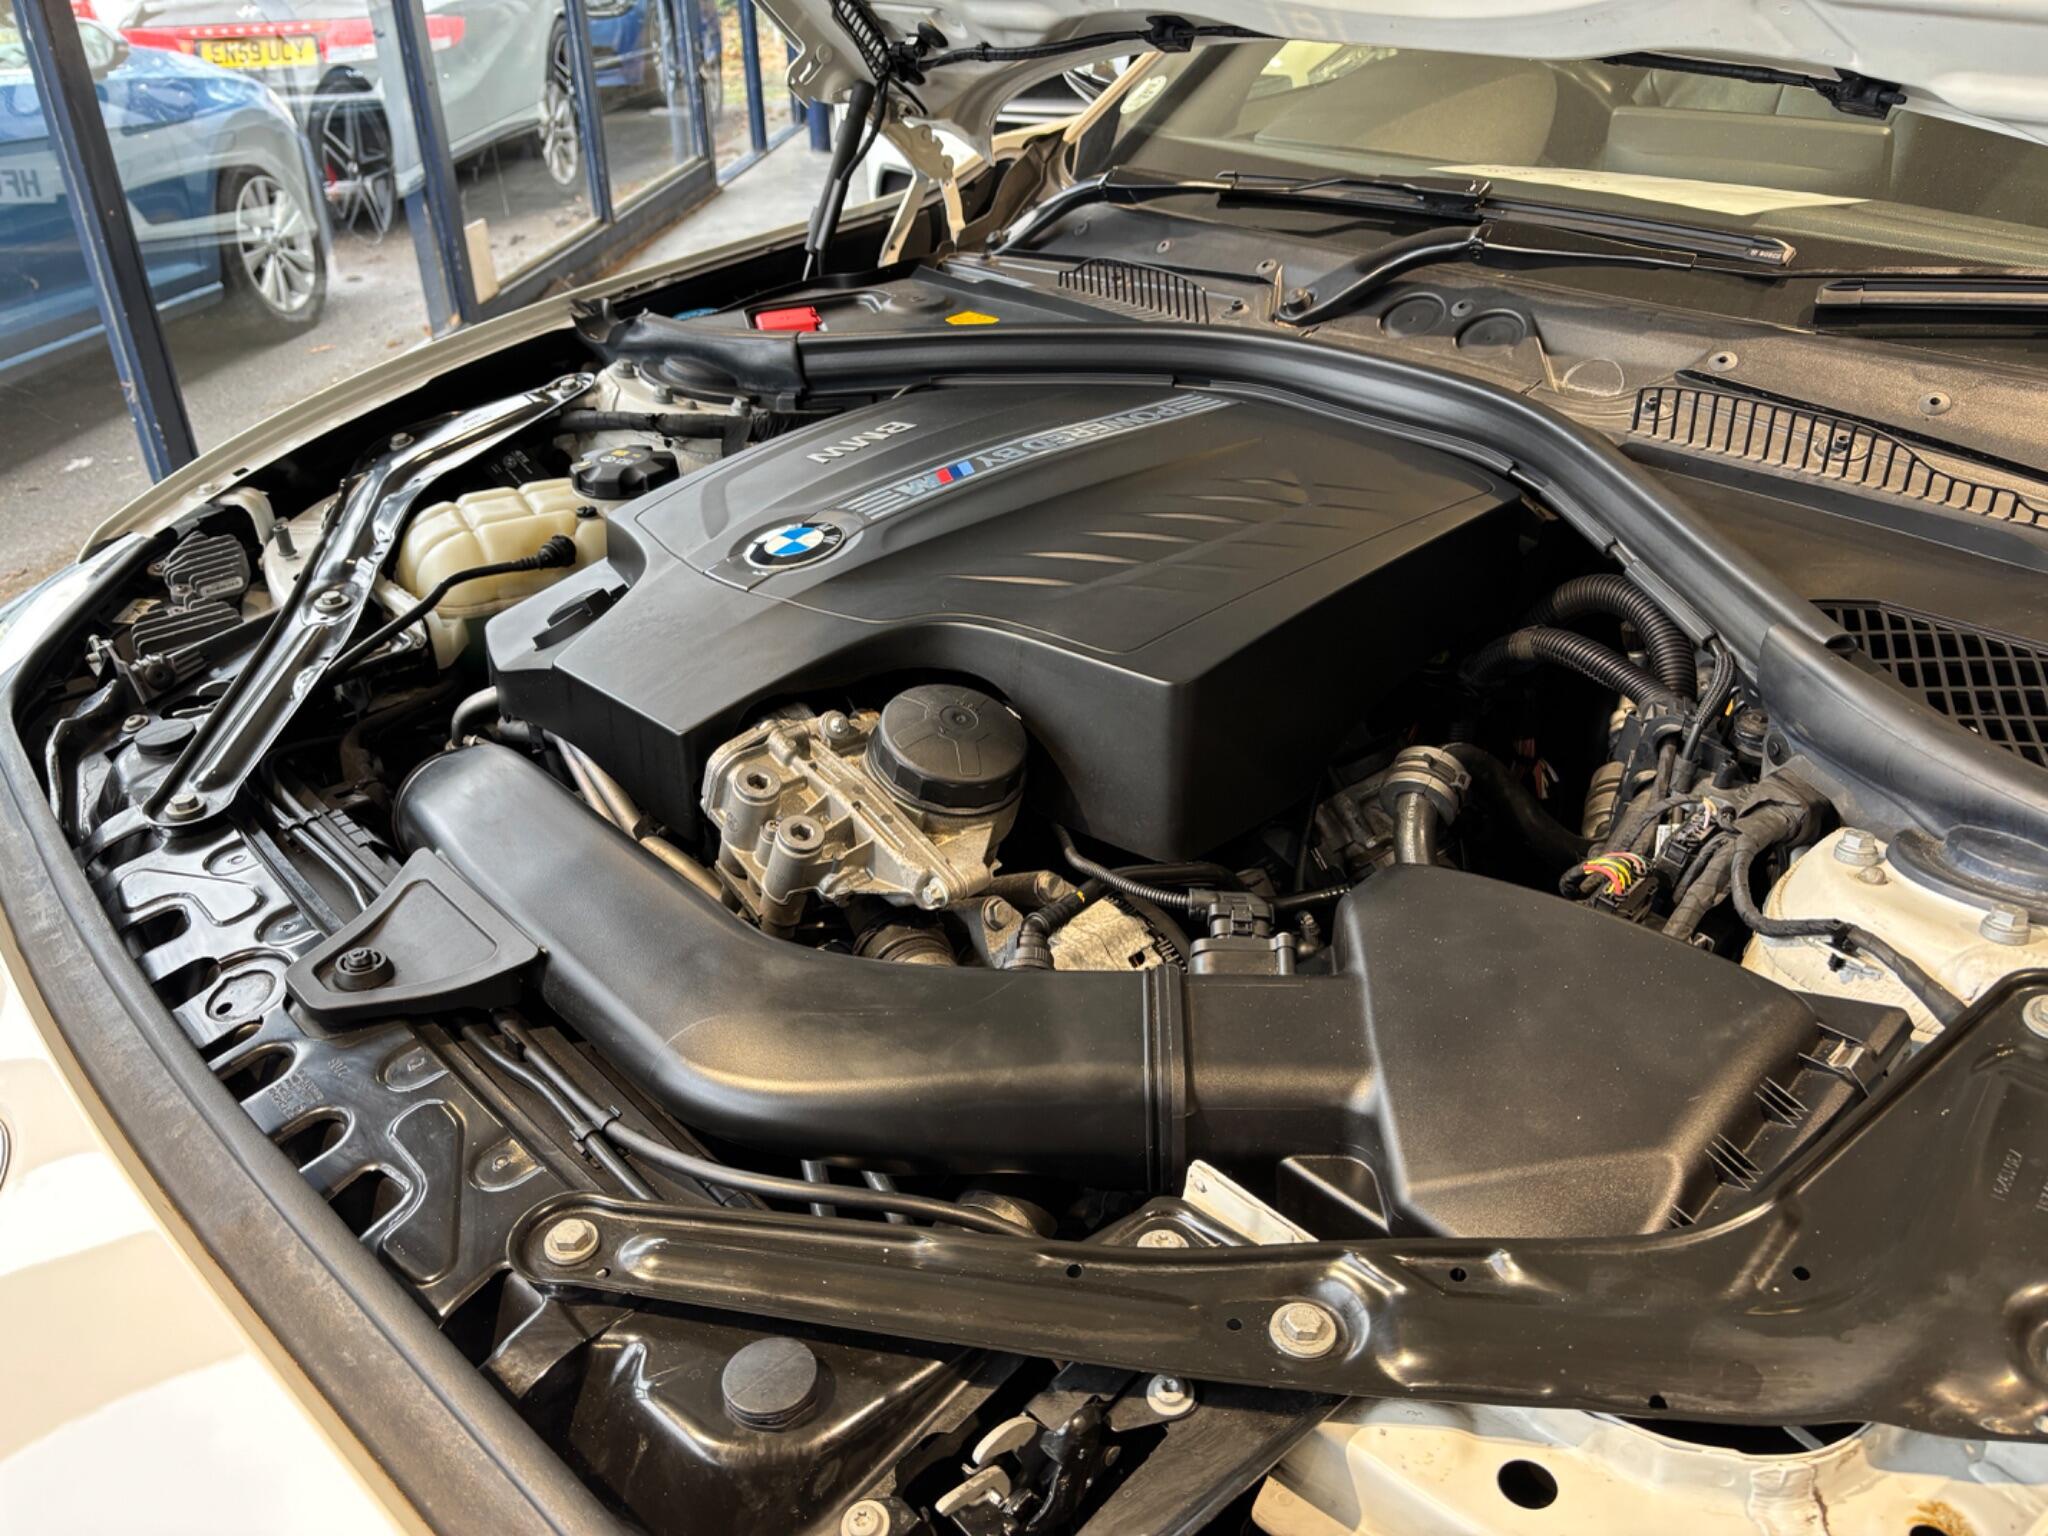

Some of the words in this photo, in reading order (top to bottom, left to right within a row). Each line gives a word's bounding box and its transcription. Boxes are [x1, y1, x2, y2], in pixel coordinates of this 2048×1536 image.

[806, 421, 918, 464] BMW
[1022, 405, 1178, 450] POWERED
[976, 448, 1029, 467] BY
